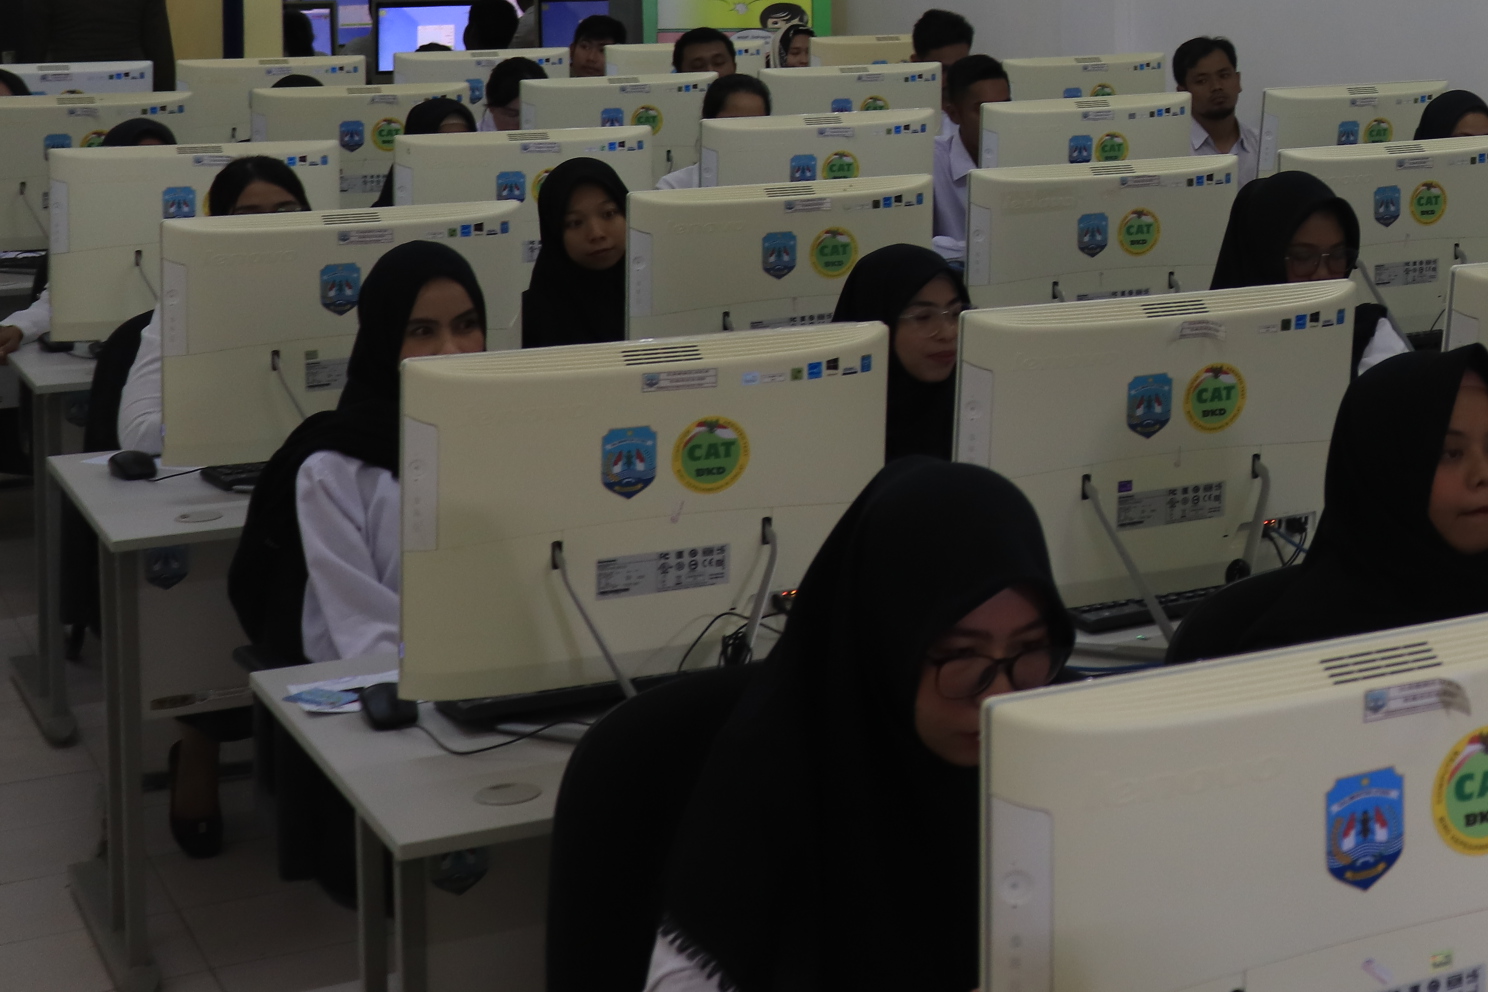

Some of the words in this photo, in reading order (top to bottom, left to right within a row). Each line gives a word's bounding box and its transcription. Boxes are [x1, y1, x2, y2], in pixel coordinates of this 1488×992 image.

[378, 129, 399, 137] CAT
[1101, 143, 1123, 153] CAT
[830, 163, 853, 173] CAT
[1416, 195, 1441, 206] CAT
[1125, 224, 1152, 236] CAT
[819, 244, 849, 257] CAT
[1196, 385, 1235, 404] CAT
[1201, 408, 1226, 418] BKD
[687, 441, 736, 462] CAT
[695, 466, 726, 478] BKD
[1086, 752, 1284, 812] lenovo
